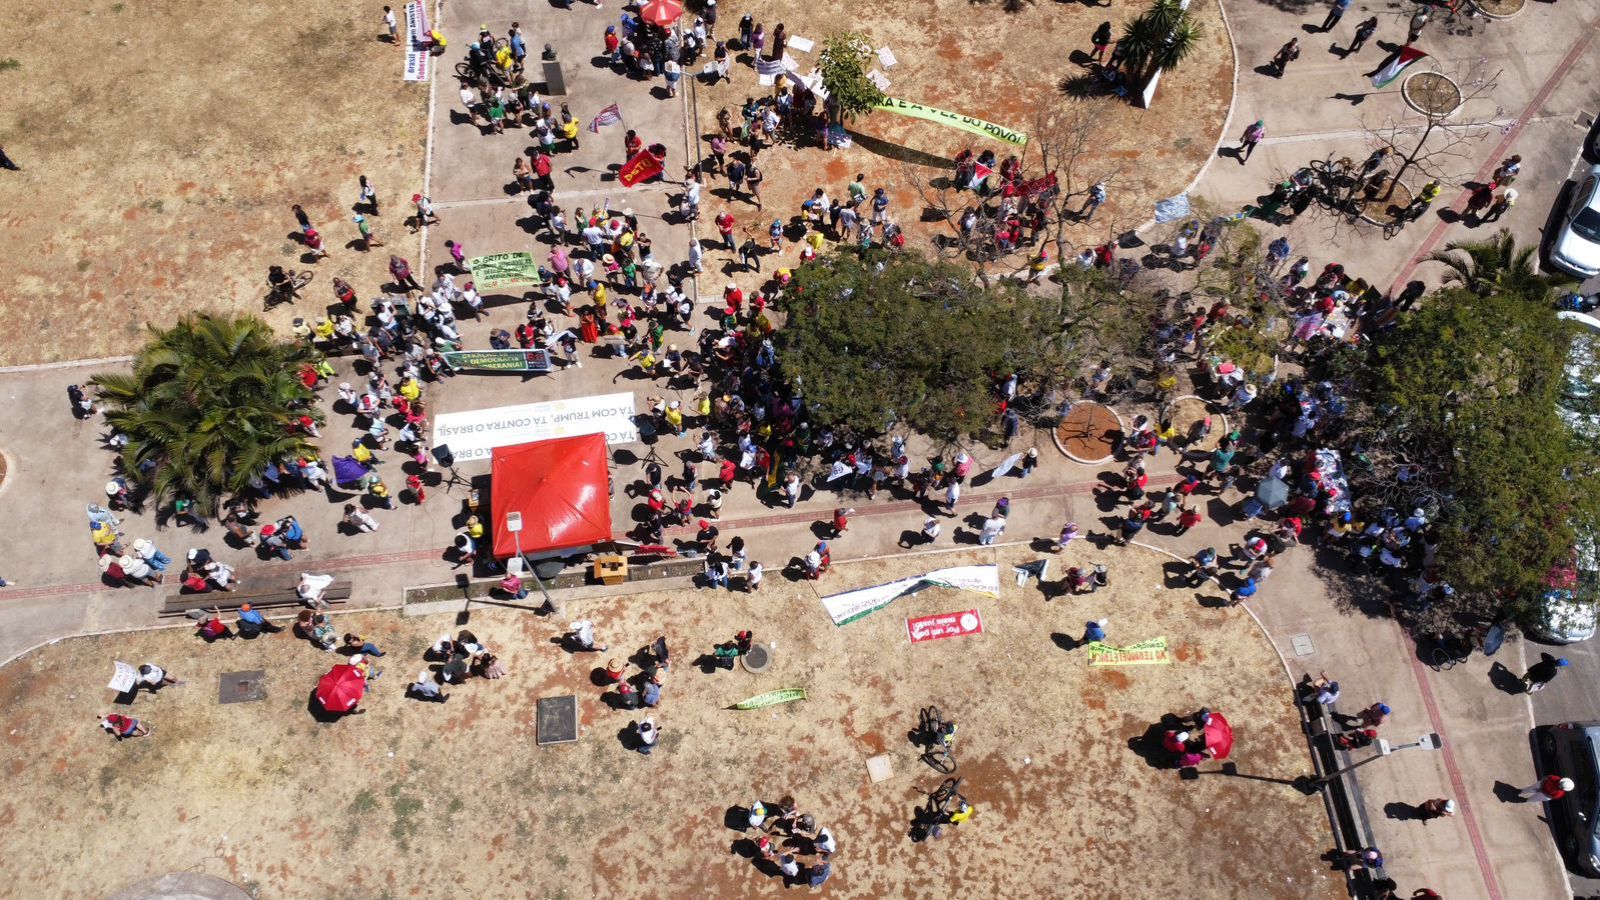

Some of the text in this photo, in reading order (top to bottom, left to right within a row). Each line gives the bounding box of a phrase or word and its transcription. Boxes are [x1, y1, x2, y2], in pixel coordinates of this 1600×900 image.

[483, 253, 509, 263] GRITO
[551, 411, 590, 423] TRUMP,
[592, 408, 617, 418] COM
[437, 424, 473, 436] BRASIL
[486, 418, 531, 430] CONTRA
